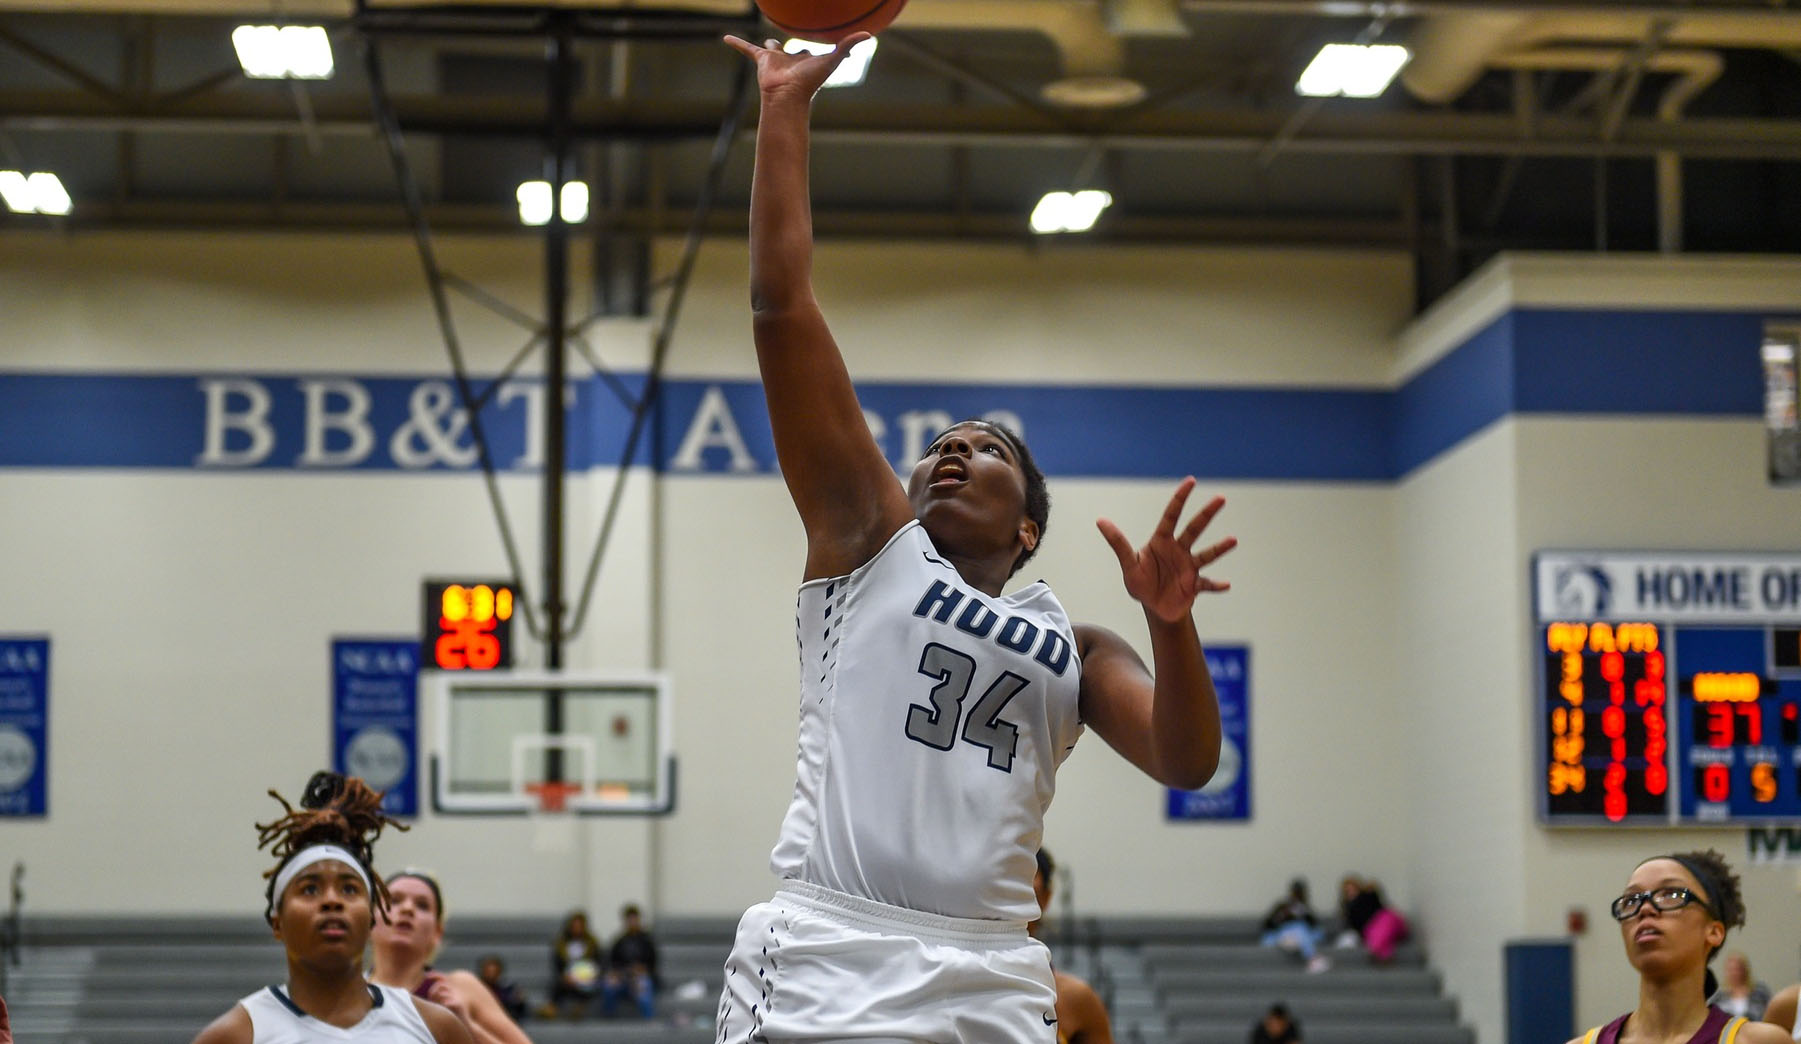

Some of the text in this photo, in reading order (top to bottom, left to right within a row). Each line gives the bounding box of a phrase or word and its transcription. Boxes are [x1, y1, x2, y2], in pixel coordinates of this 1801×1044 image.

[196, 379, 576, 468] BB&T
[1637, 566, 1752, 612] HOME
[912, 578, 1072, 677] HOOD
[905, 641, 1031, 774] 34
[1707, 701, 1762, 748] 37
[1704, 762, 1729, 802] 0
